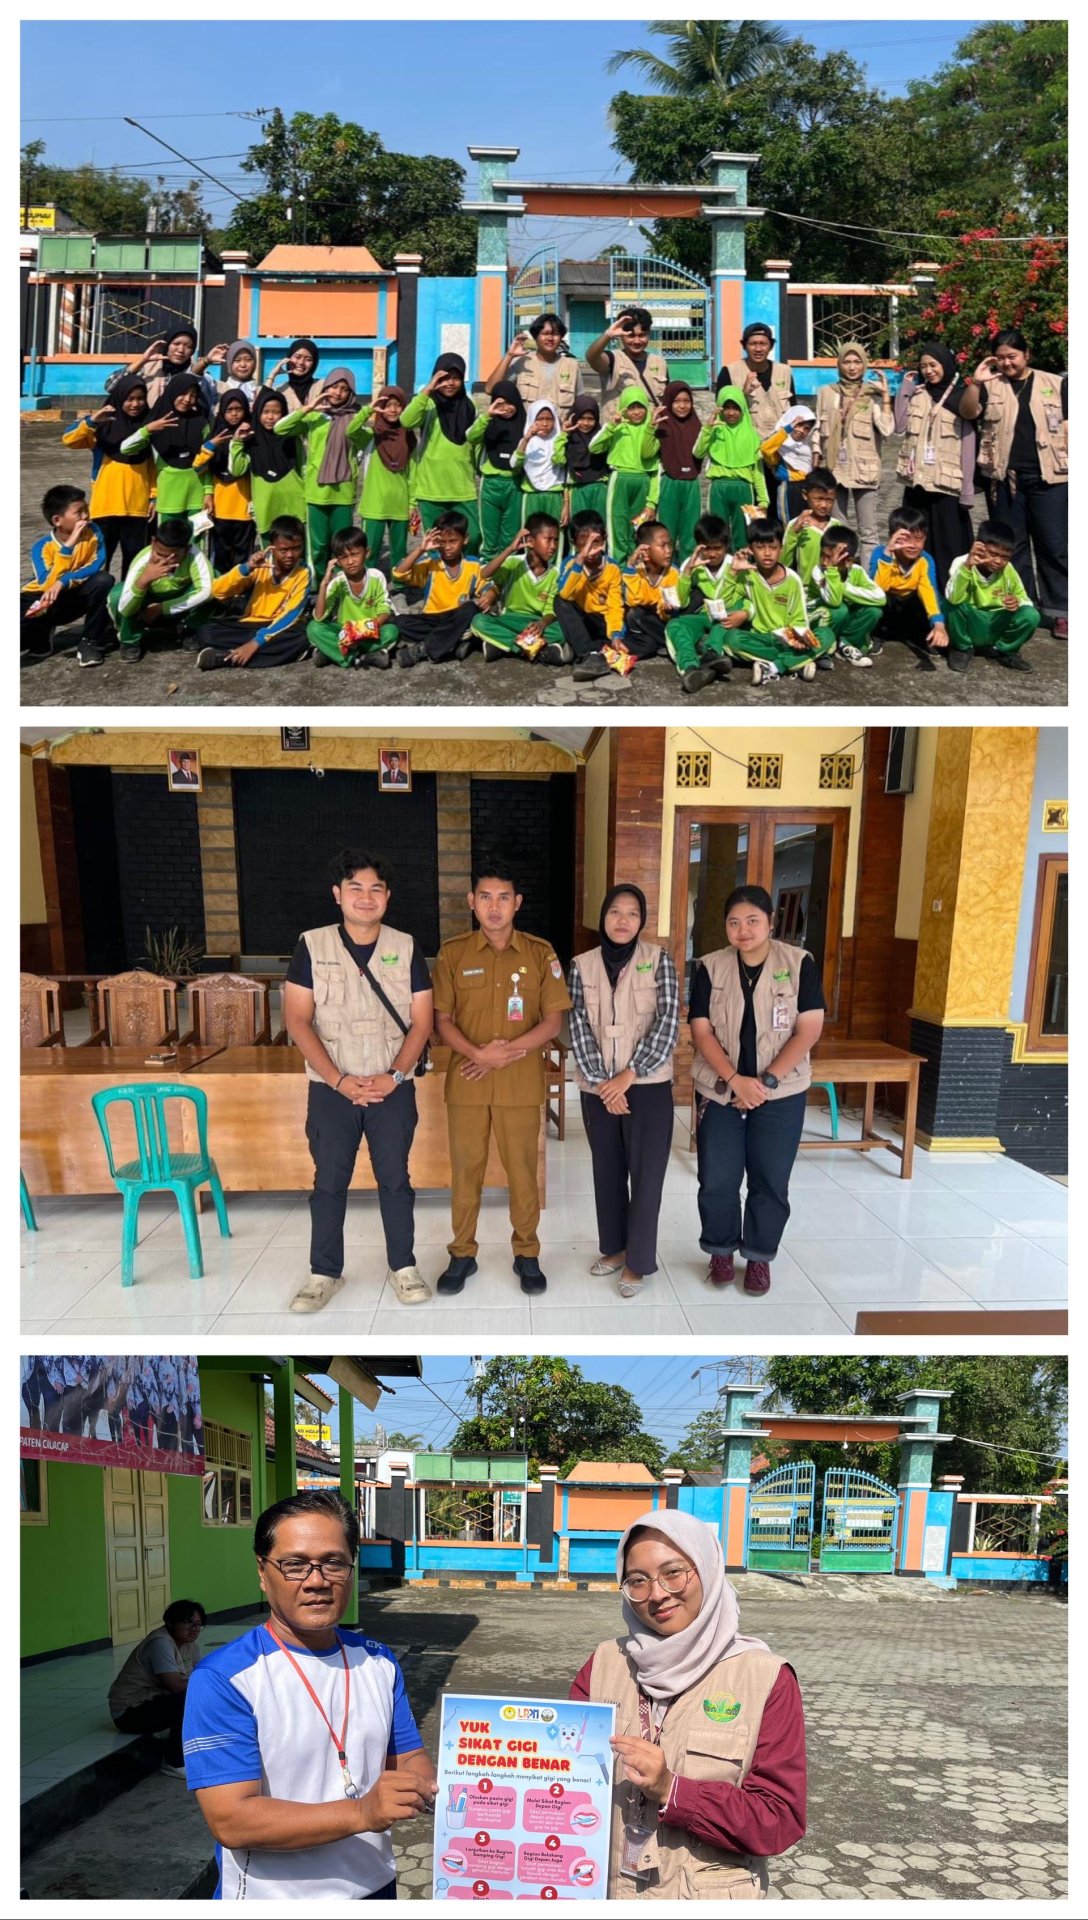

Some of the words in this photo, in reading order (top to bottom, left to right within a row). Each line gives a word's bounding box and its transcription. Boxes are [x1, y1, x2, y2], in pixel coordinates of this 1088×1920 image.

[42, 1440, 69, 1451] CILACAP
[459, 1720, 490, 1734] YUK
[458, 1737, 503, 1750] SIKAT
[506, 1740, 538, 1753] GIGI
[457, 1753, 518, 1768] DENGAN
[522, 1757, 571, 1772] BENAR
[466, 1770, 514, 1779] langkah-langkah
[553, 1786, 560, 1794] 2
[478, 1834, 486, 1842] 3
[549, 1839, 557, 1847] 4
[477, 1884, 484, 1892] 5
[545, 1890, 553, 1898] 6
